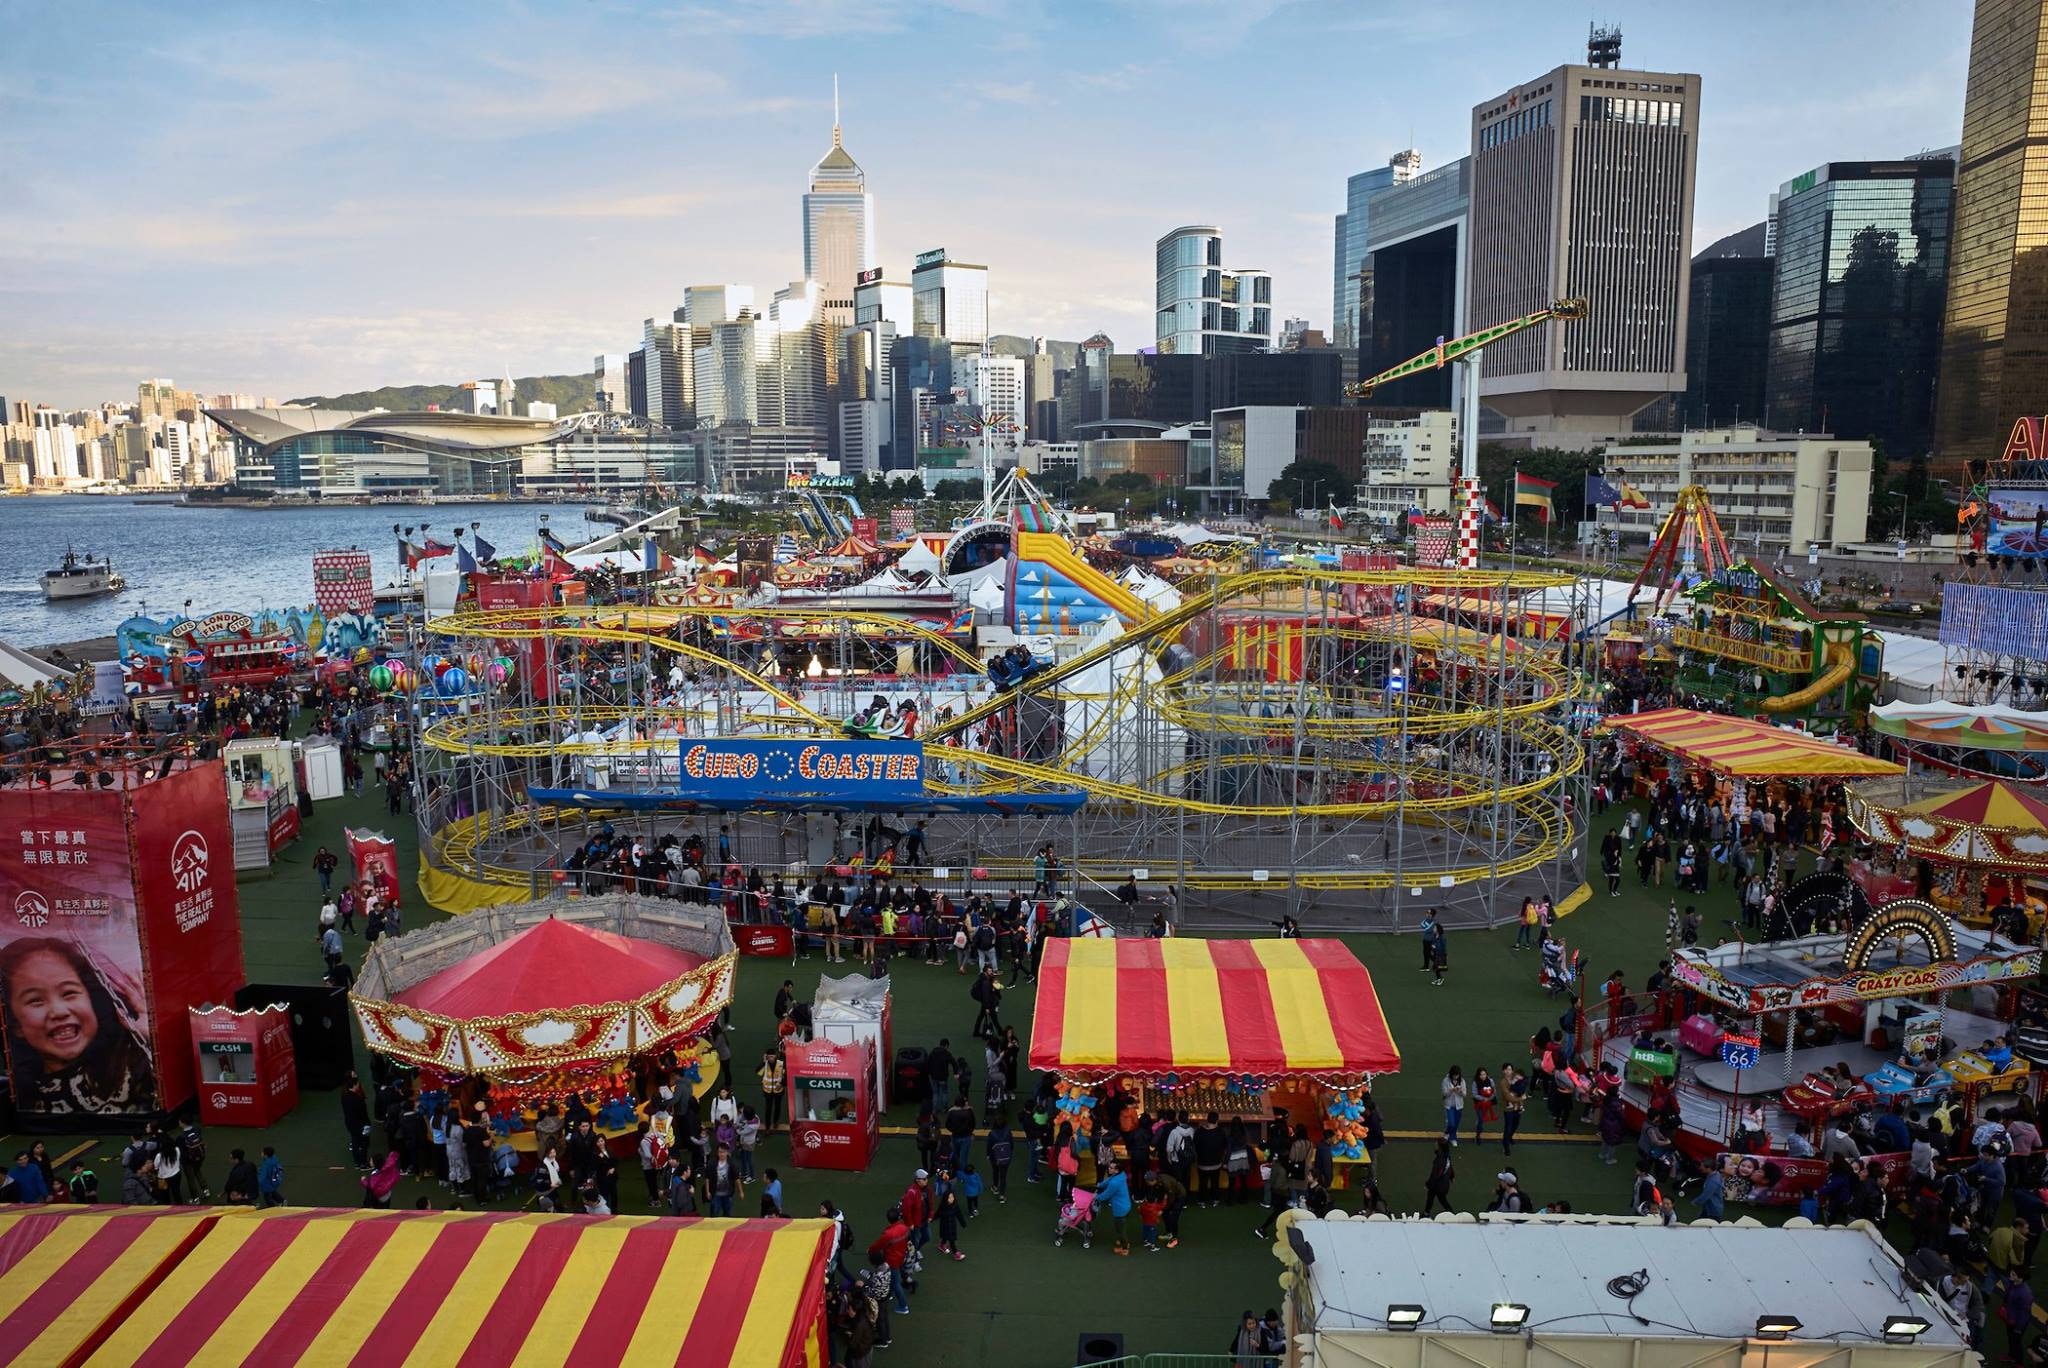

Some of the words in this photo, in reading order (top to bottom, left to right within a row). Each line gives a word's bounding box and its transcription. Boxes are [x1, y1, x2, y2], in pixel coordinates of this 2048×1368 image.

[788, 472, 810, 487] BIG
[810, 474, 855, 487] SPLASH
[1730, 571, 1758, 589] HOUSE
[203, 614, 240, 627] LONDO
[230, 617, 250, 632] STOP
[174, 622, 194, 636] BUS
[203, 622, 224, 637] FUN
[684, 745, 760, 780] EURO
[799, 745, 921, 780] COASTER
[20, 830, 87, 846] 當下最真
[23, 850, 89, 865] 無限歡欣
[176, 866, 208, 893] AIA
[176, 911, 189, 925] THE
[188, 904, 202, 921] REAL
[202, 897, 214, 913] LIFE
[19, 913, 49, 928] AIA
[181, 913, 210, 934] COMPANY
[1857, 976, 1903, 993] CRAZY
[1904, 971, 1937, 987] CARS
[212, 1044, 241, 1052] CASH
[809, 1056, 838, 1064] CARNIVAL
[1634, 1051, 1655, 1062] htB
[1729, 1050, 1749, 1066] 66
[809, 1080, 842, 1089] CASH
